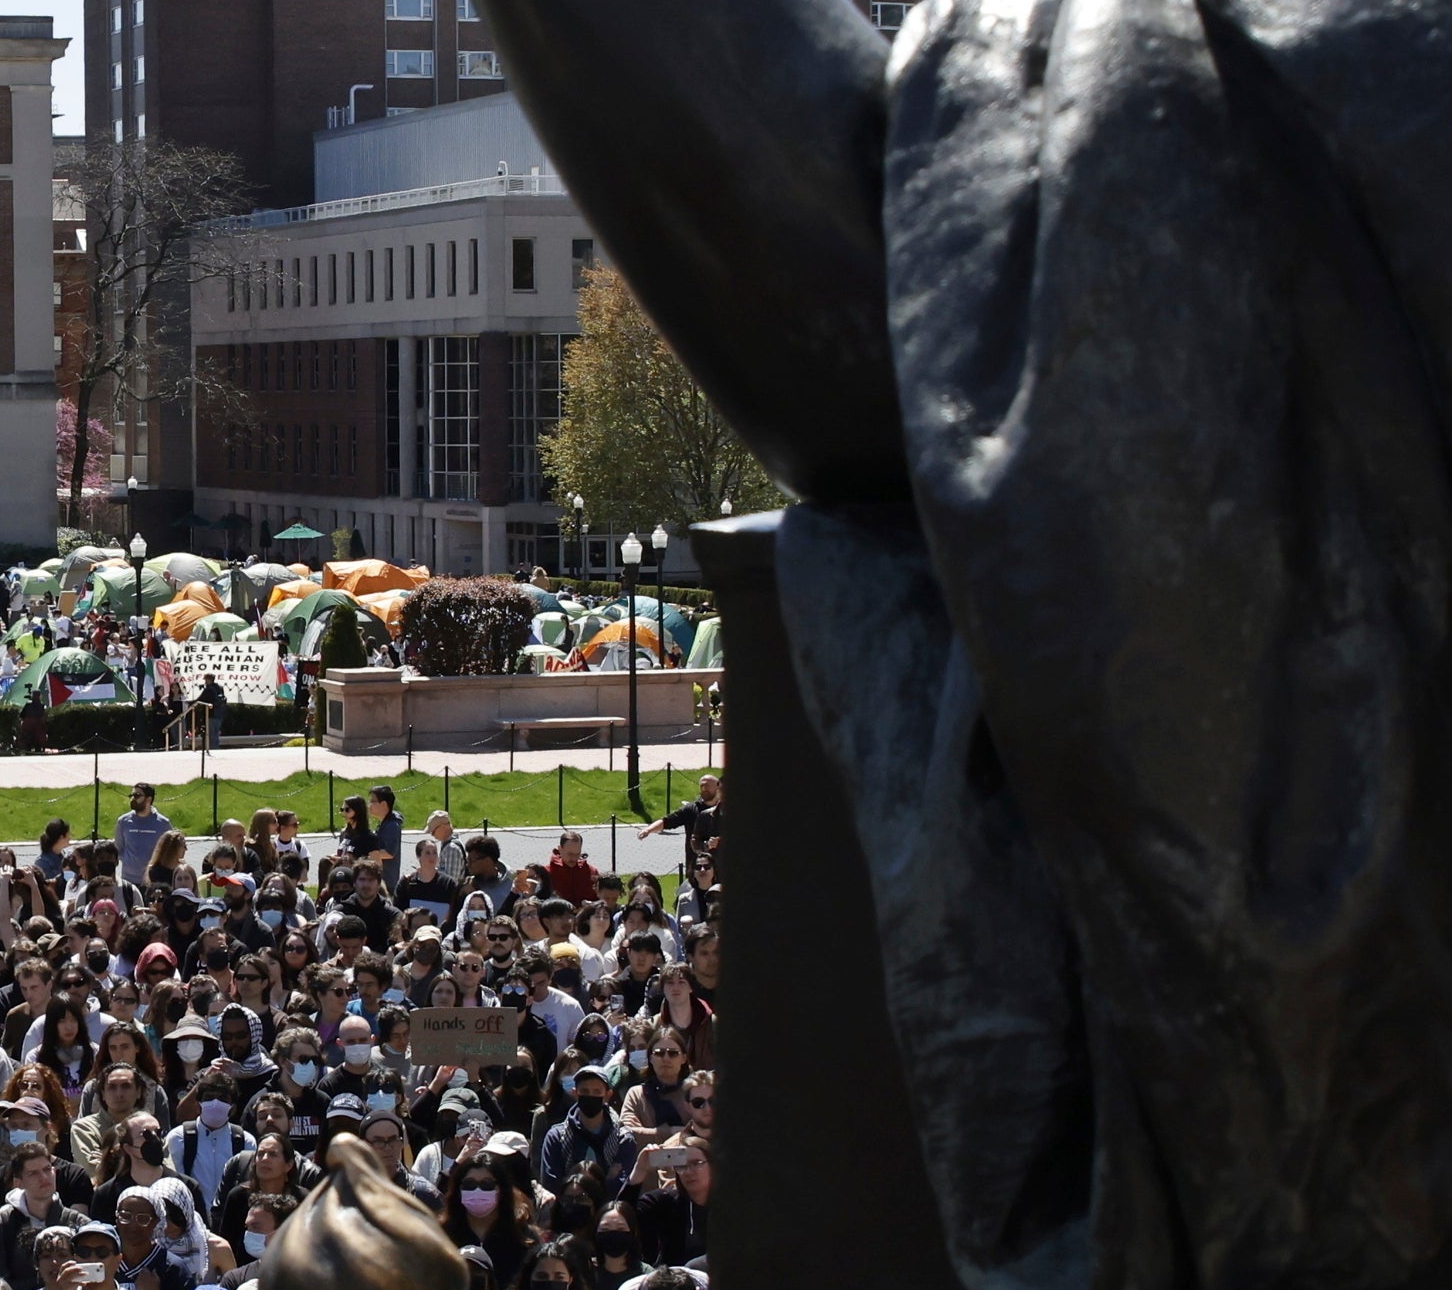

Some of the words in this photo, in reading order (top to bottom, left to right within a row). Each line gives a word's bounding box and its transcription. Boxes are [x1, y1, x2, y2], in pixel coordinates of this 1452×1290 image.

[221, 645, 257, 654] ALL
[174, 653, 265, 665] ALESTINIAN
[173, 663, 261, 675] RISONERS
[228, 674, 263, 683] NOW
[424, 1017, 466, 1031] Hands
